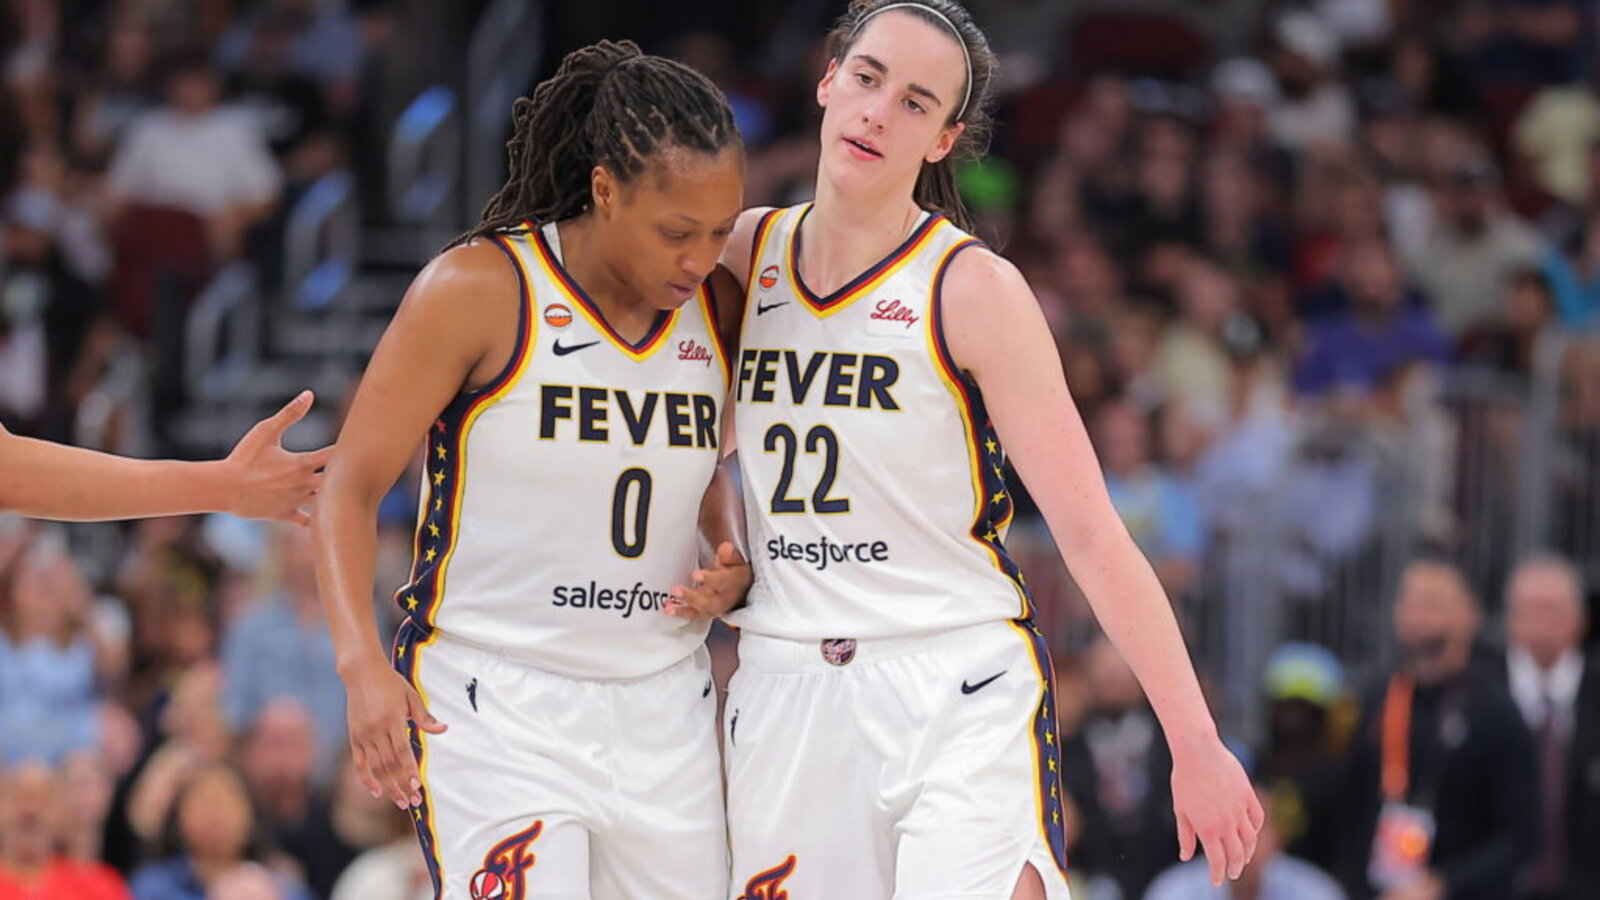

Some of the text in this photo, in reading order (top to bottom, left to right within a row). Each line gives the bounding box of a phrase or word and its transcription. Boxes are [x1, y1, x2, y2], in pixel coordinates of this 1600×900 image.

[870, 299, 920, 329] Lilly
[677, 339, 713, 368] Lilly
[737, 348, 904, 413] FEVER
[537, 383, 719, 449] FEVER
[764, 422, 851, 515] 22
[611, 466, 652, 559] 0
